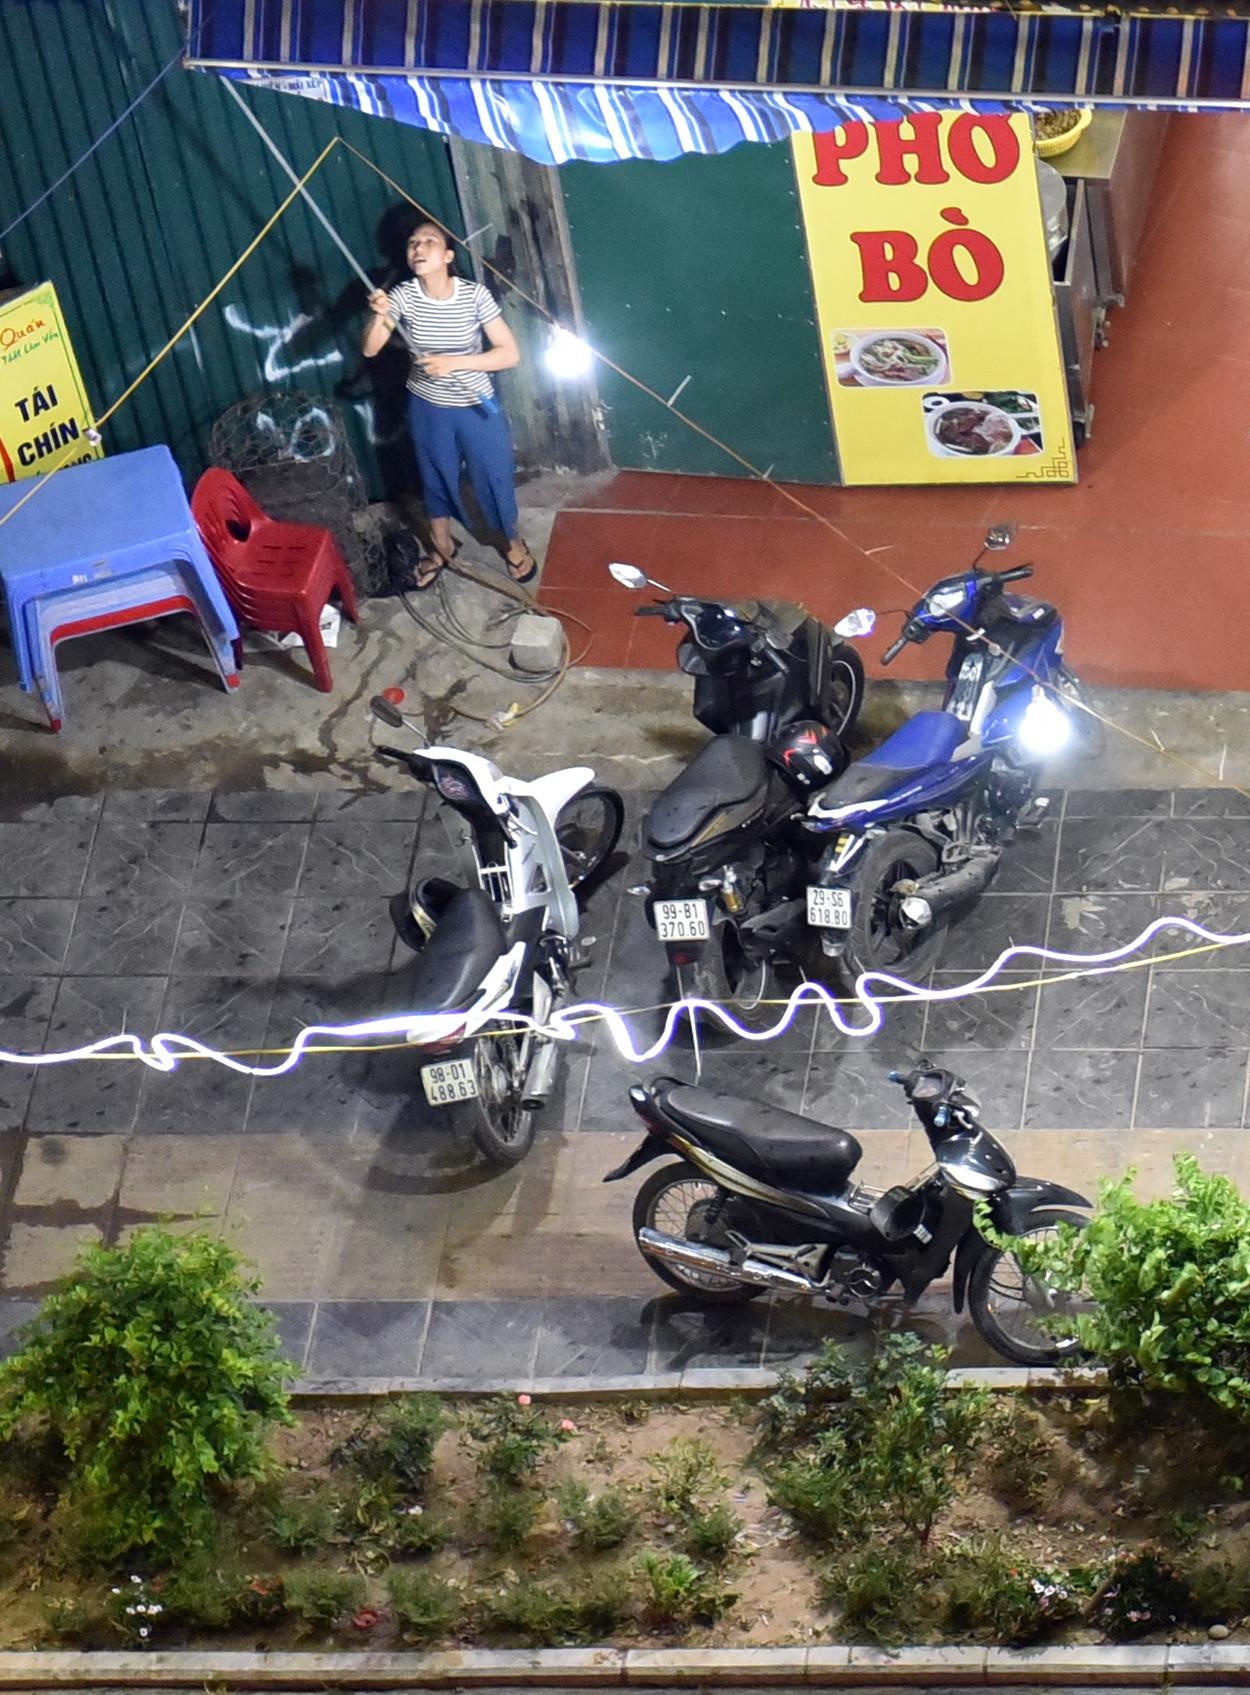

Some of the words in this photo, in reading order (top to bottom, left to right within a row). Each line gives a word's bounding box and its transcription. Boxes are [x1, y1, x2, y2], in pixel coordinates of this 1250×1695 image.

[849, 206, 1005, 303] BÒ
[15, 384, 59, 423] TÁI
[17, 417, 79, 467] CHÍN
[661, 921, 705, 938] 370.60
[662, 903, 698, 920] 99-B1
